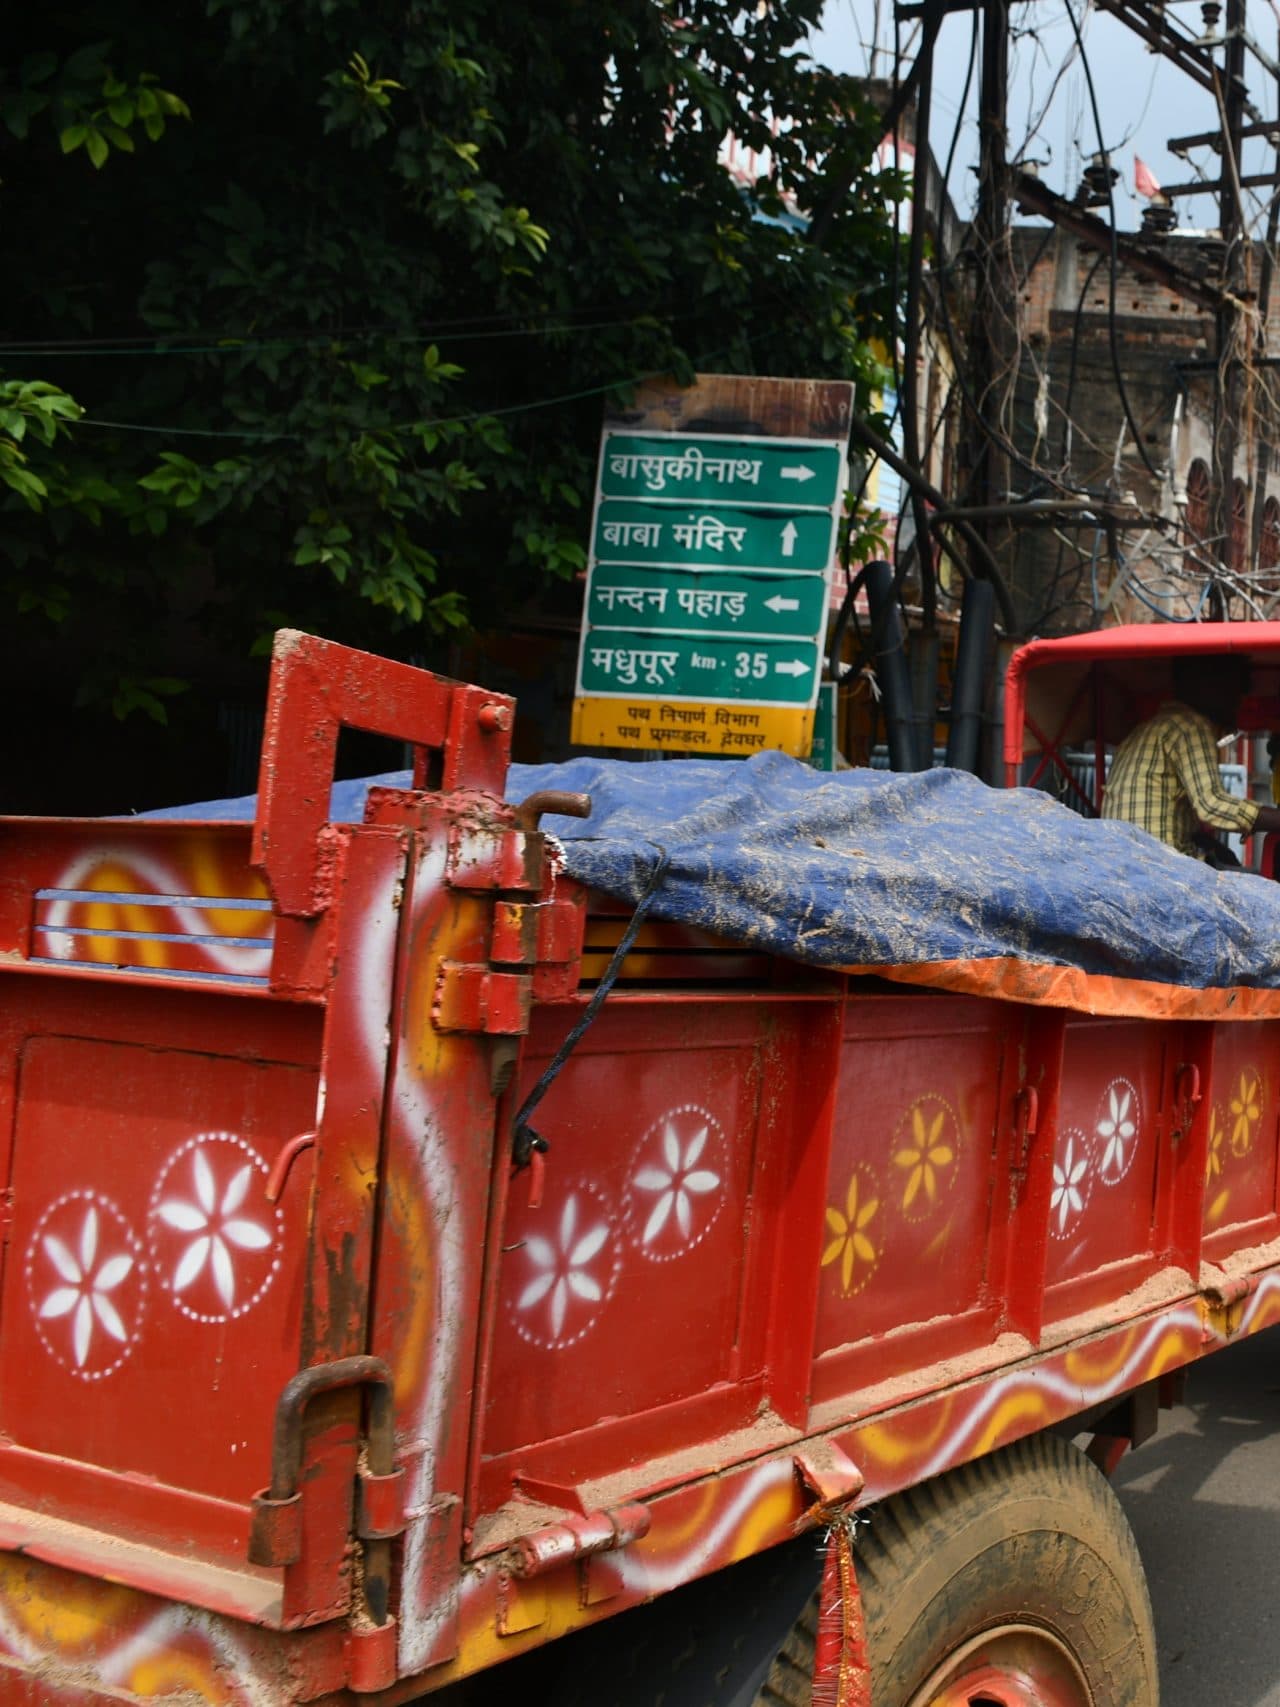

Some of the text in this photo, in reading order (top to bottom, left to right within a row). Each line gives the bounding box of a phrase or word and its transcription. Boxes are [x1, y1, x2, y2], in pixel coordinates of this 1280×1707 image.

[609, 447, 762, 491] बासुकीनाथ
[602, 514, 747, 553] बाबा मंदिर
[595, 585, 748, 622] नन्दन पहाड़
[589, 647, 680, 685] मधुपूर
[734, 651, 768, 679] 35
[627, 706, 651, 721] पथ
[715, 707, 760, 728] विभाग
[617, 725, 641, 739] पथ
[720, 728, 767, 747] देवघर
